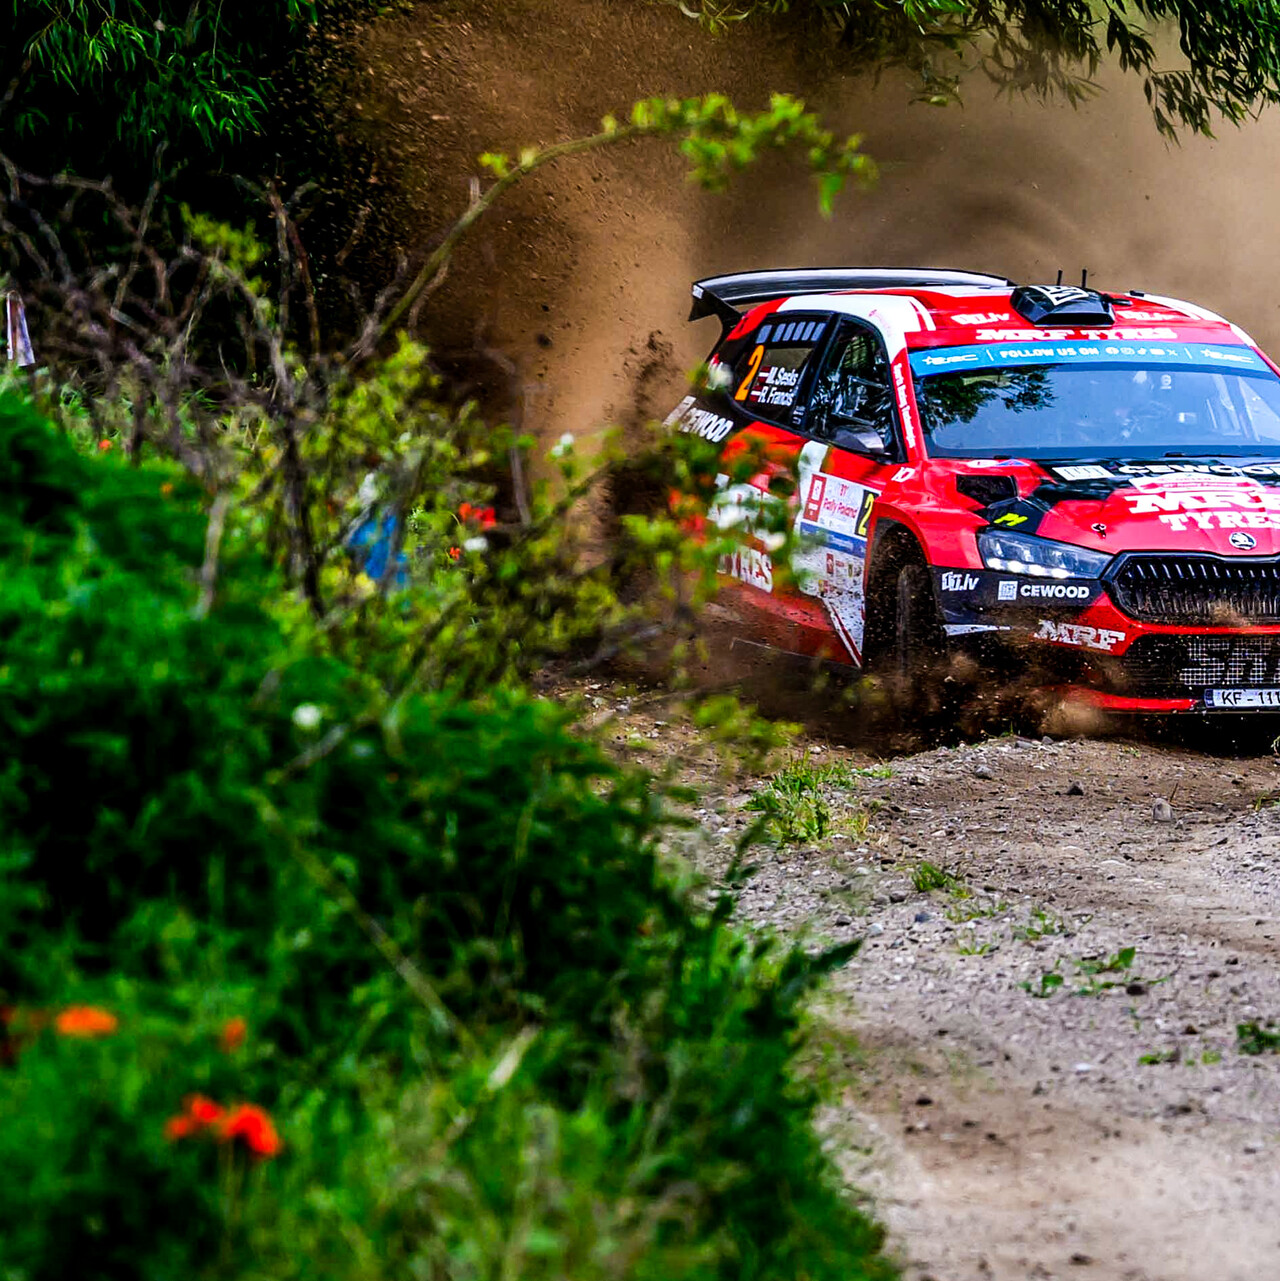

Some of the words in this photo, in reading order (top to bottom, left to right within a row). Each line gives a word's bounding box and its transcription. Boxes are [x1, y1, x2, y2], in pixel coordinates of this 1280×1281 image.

[976, 329, 1074, 341] MRF
[1081, 328, 1178, 340] TYRES
[1000, 349, 1054, 358] FOLLOW
[1057, 347, 1076, 356] US
[1079, 347, 1099, 356] ON
[734, 344, 765, 400] 2
[858, 493, 875, 536] 2
[1020, 584, 1090, 599] CEWOOD
[1034, 620, 1126, 651] MRF
